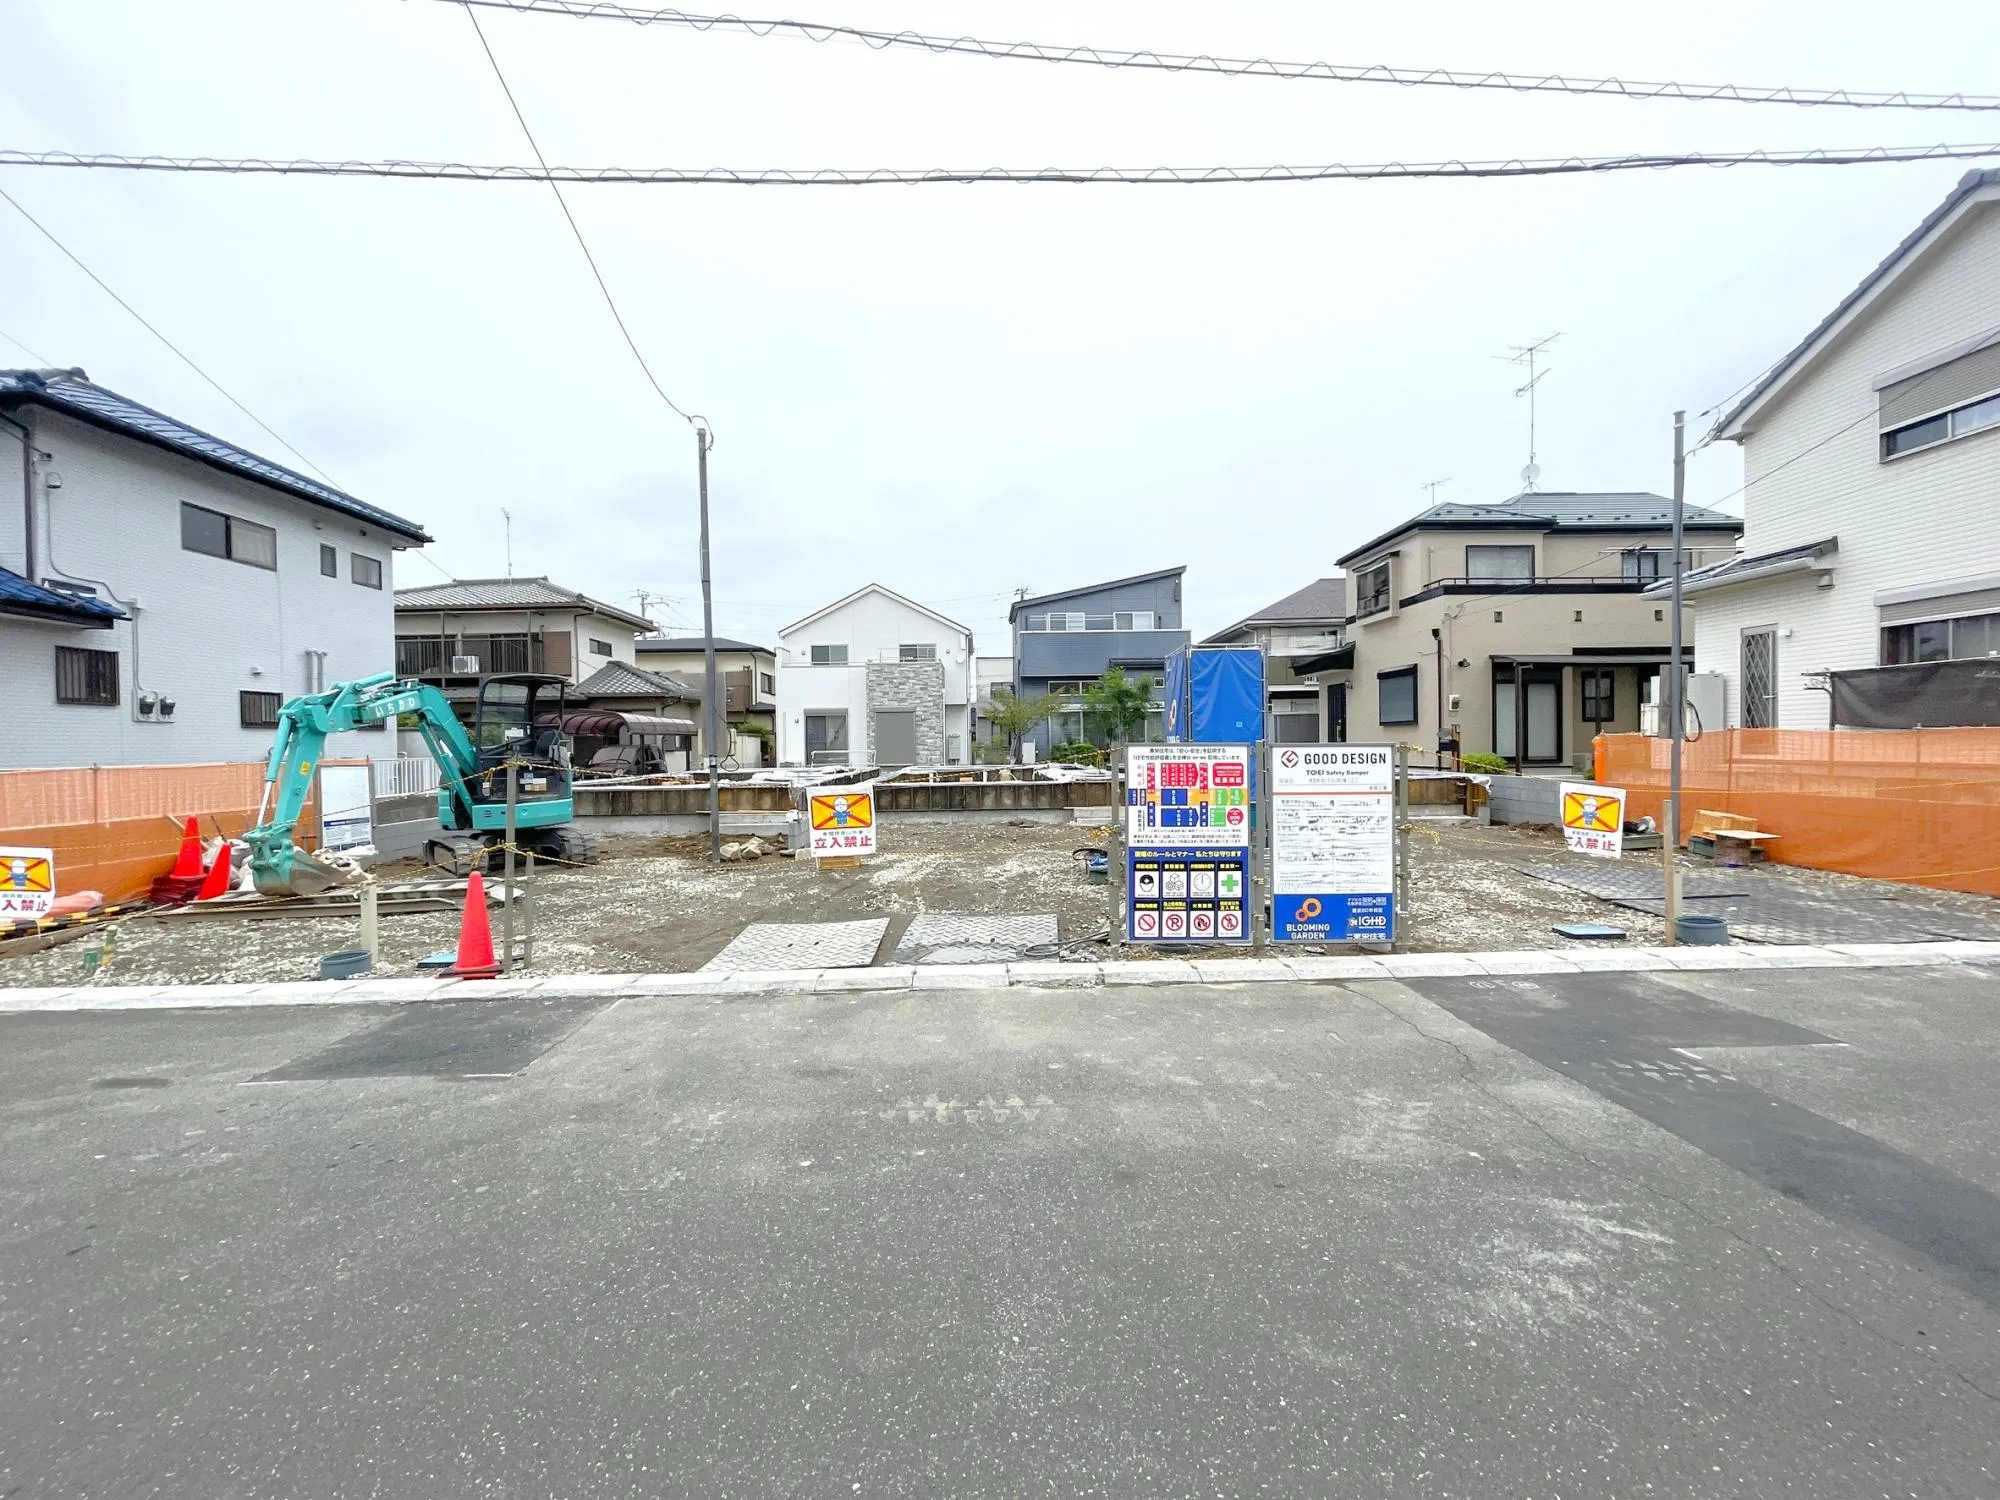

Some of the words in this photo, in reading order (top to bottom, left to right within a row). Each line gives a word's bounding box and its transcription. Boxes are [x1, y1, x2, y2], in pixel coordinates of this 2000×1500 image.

[1304, 753, 1338, 765] GOOD
[1342, 752, 1386, 765] DESIGN
[1326, 769, 1345, 777] Safety
[814, 835, 873, 850] 立入禁止
[1358, 916, 1387, 926] IGHD
[1286, 923, 1330, 932] BLOOMING
[1291, 931, 1325, 939] GARDEN
